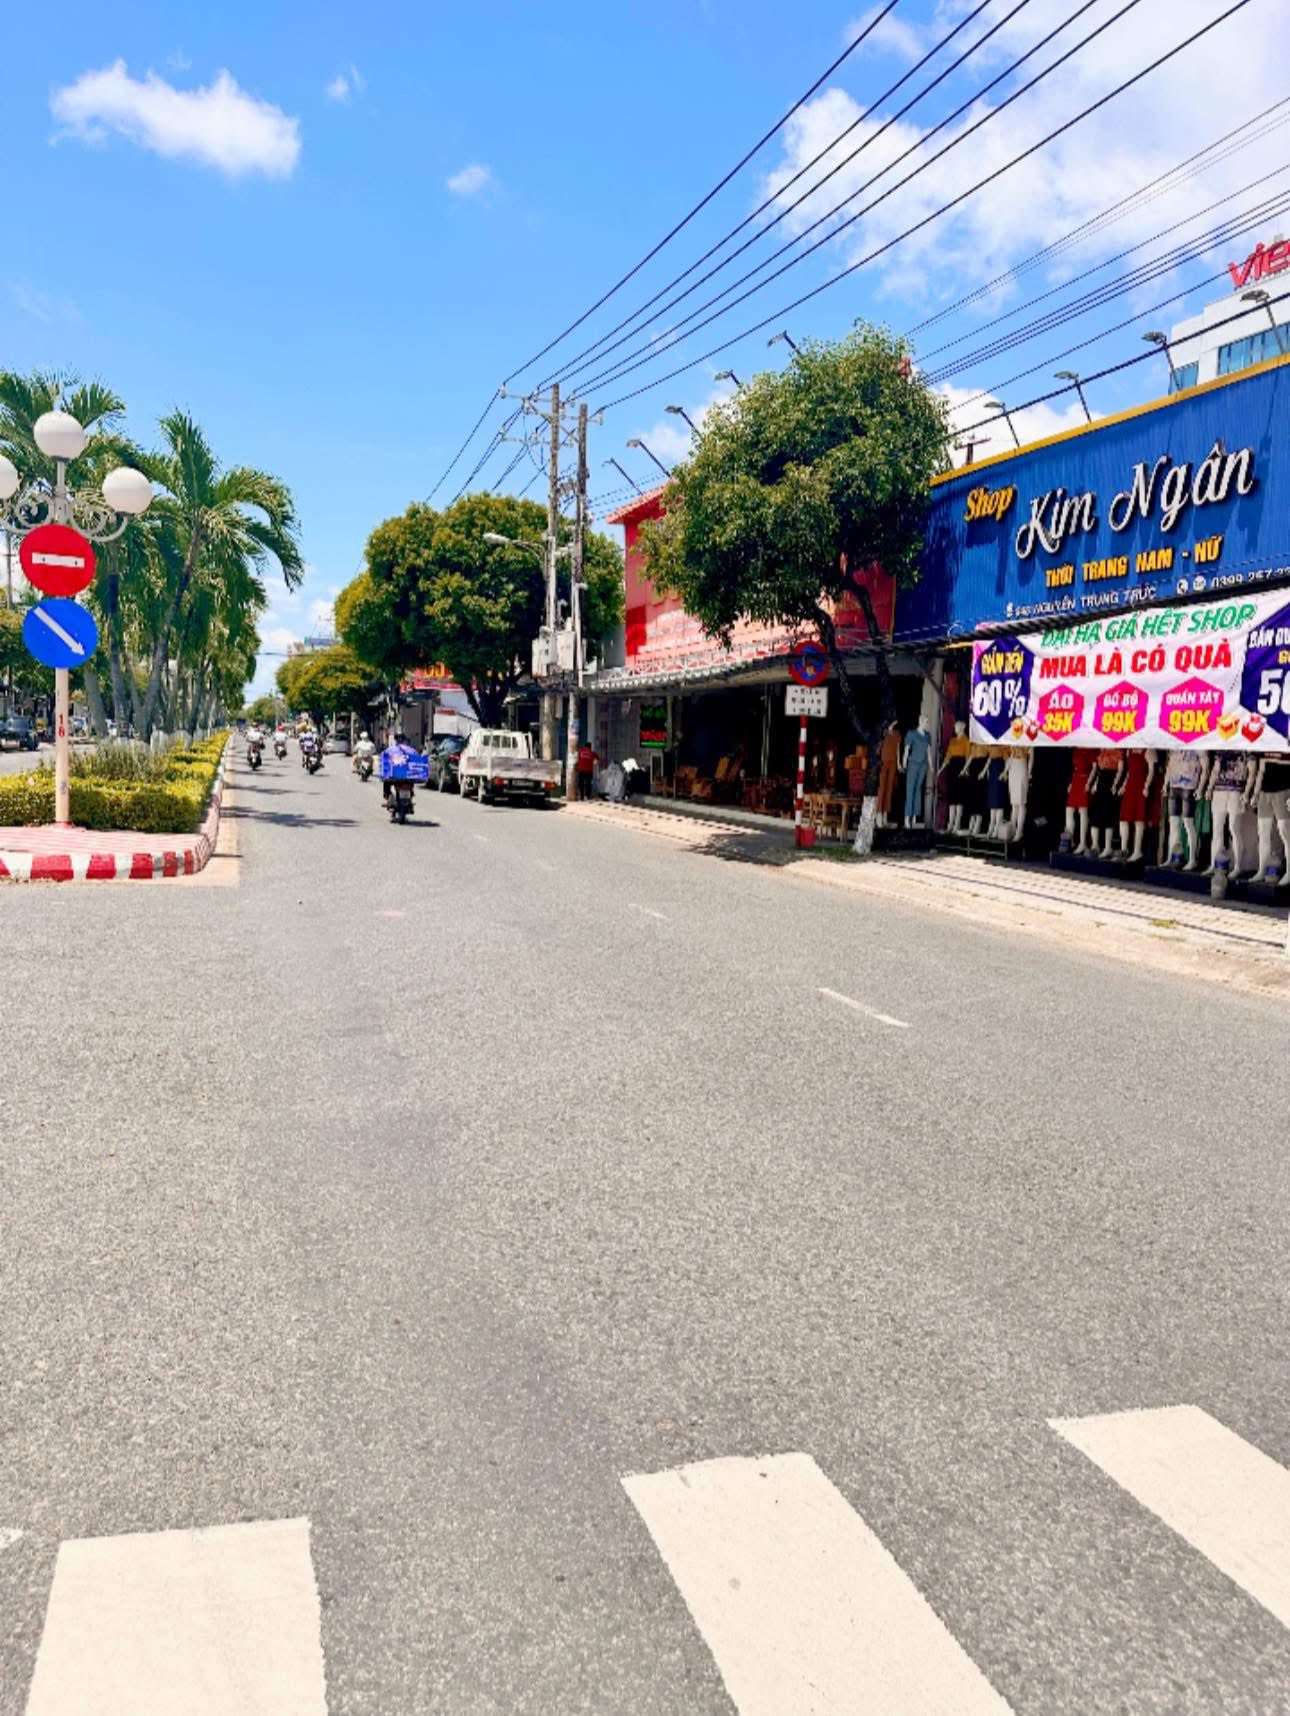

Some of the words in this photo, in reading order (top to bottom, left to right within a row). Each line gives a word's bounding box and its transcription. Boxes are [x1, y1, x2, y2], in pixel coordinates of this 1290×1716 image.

[965, 486, 1014, 521] Shop
[1015, 487, 1096, 559] Kim
[1109, 441, 1253, 532] Ngân
[1082, 556, 1129, 582] TRANG
[1136, 548, 1173, 573] NAM
[1194, 535, 1224, 563] NỮ
[1080, 591, 1119, 608] TRUNG
[1105, 611, 1142, 641] GIÁ
[1141, 608, 1186, 637] HẾT
[1187, 603, 1256, 633] SHOP
[1248, 626, 1274, 648] BÁN
[1039, 657, 1087, 679] MUA
[1094, 648, 1123, 676] LÀ
[1131, 643, 1166, 673] CÓ
[1174, 639, 1232, 671] QUÀ
[973, 678, 1026, 719] 60%
[1048, 690, 1074, 709] ÁO
[1042, 710, 1076, 733] 35K
[1102, 710, 1137, 733] 99K
[1169, 709, 1212, 733] 99K
